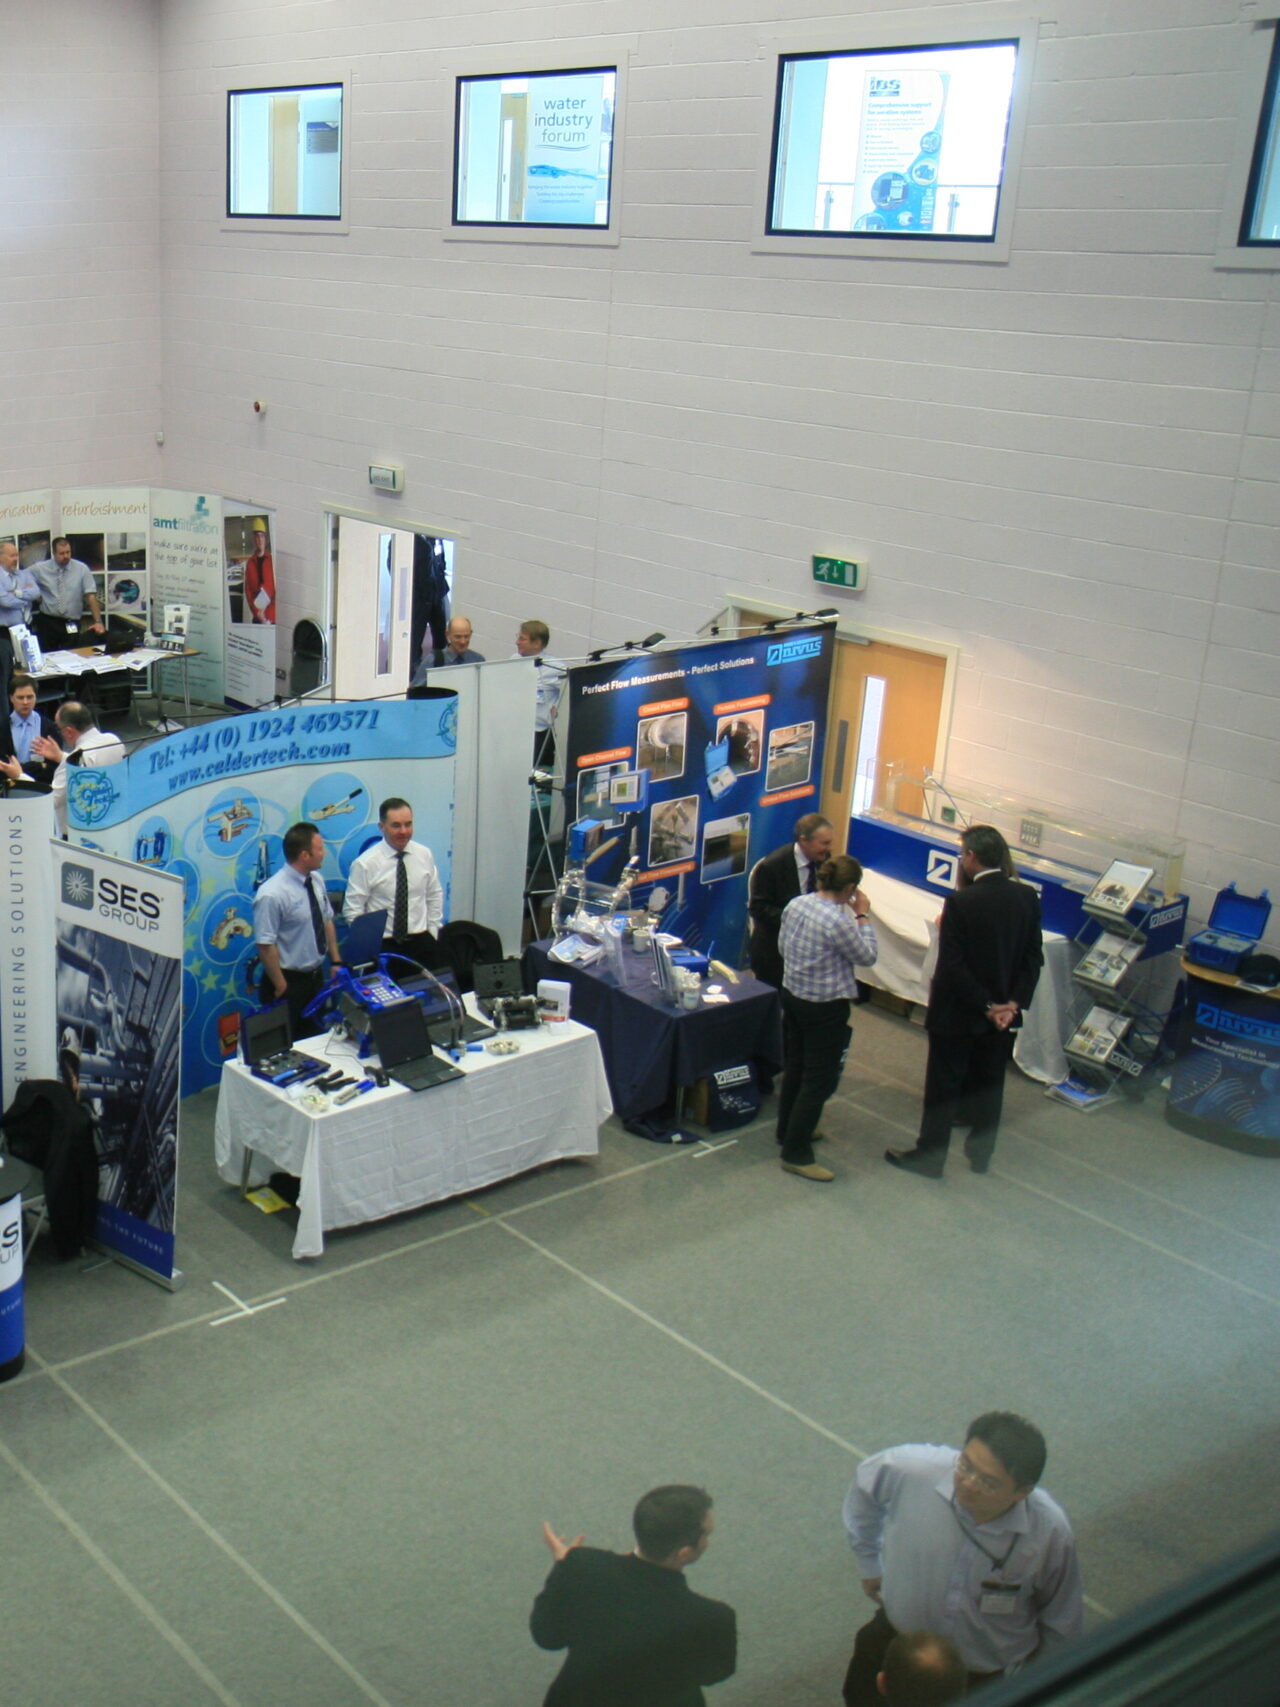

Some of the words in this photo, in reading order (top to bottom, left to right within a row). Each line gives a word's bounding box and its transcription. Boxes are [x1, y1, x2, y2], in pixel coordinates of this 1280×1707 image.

[534, 113, 593, 129] industry
[544, 97, 586, 110] water
[542, 129, 585, 142] forum
[62, 500, 147, 518] refurbishment
[582, 683, 610, 695] Perfect
[611, 680, 630, 691] Flow
[631, 669, 686, 686] Measurements
[691, 664, 719, 676] Perfect
[720, 656, 755, 671] Solutions
[149, 746, 175, 774] Tel:
[180, 732, 210, 757] +44
[214, 725, 241, 751] (0)
[247, 714, 295, 743] 1924
[301, 708, 380, 734] 469571
[168, 741, 351, 791] www.caldertech.com
[8, 815, 25, 934] SOLUTIONS
[97, 878, 161, 919] SES
[98, 903, 160, 934] GROUP
[10, 947, 29, 1085] ENGINEERING
